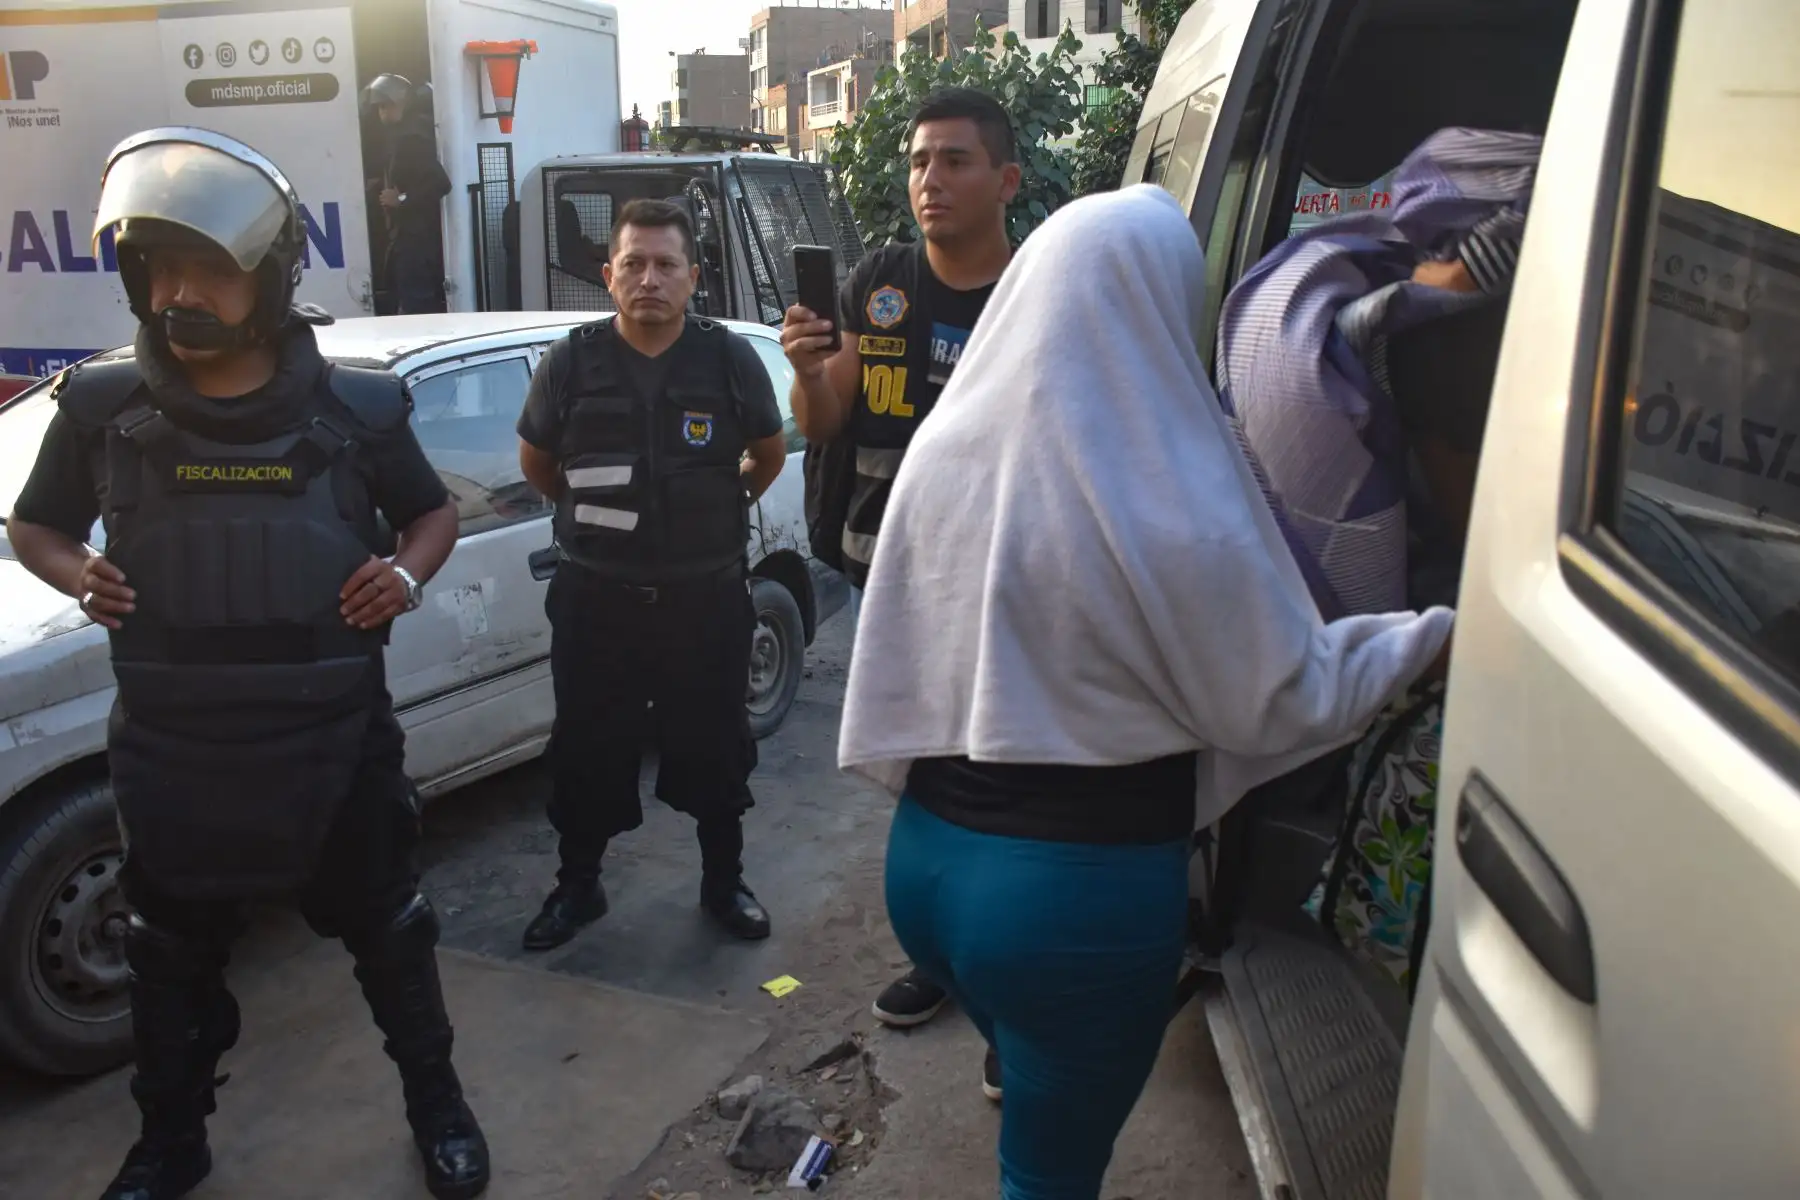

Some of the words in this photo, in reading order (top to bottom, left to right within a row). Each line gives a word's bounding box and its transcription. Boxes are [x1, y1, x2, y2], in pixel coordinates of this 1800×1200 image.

[0, 51, 50, 100] P
[211, 78, 311, 101] mdsmp.oficial
[864, 363, 914, 417] OL
[176, 465, 292, 480] FISCALIZACION
